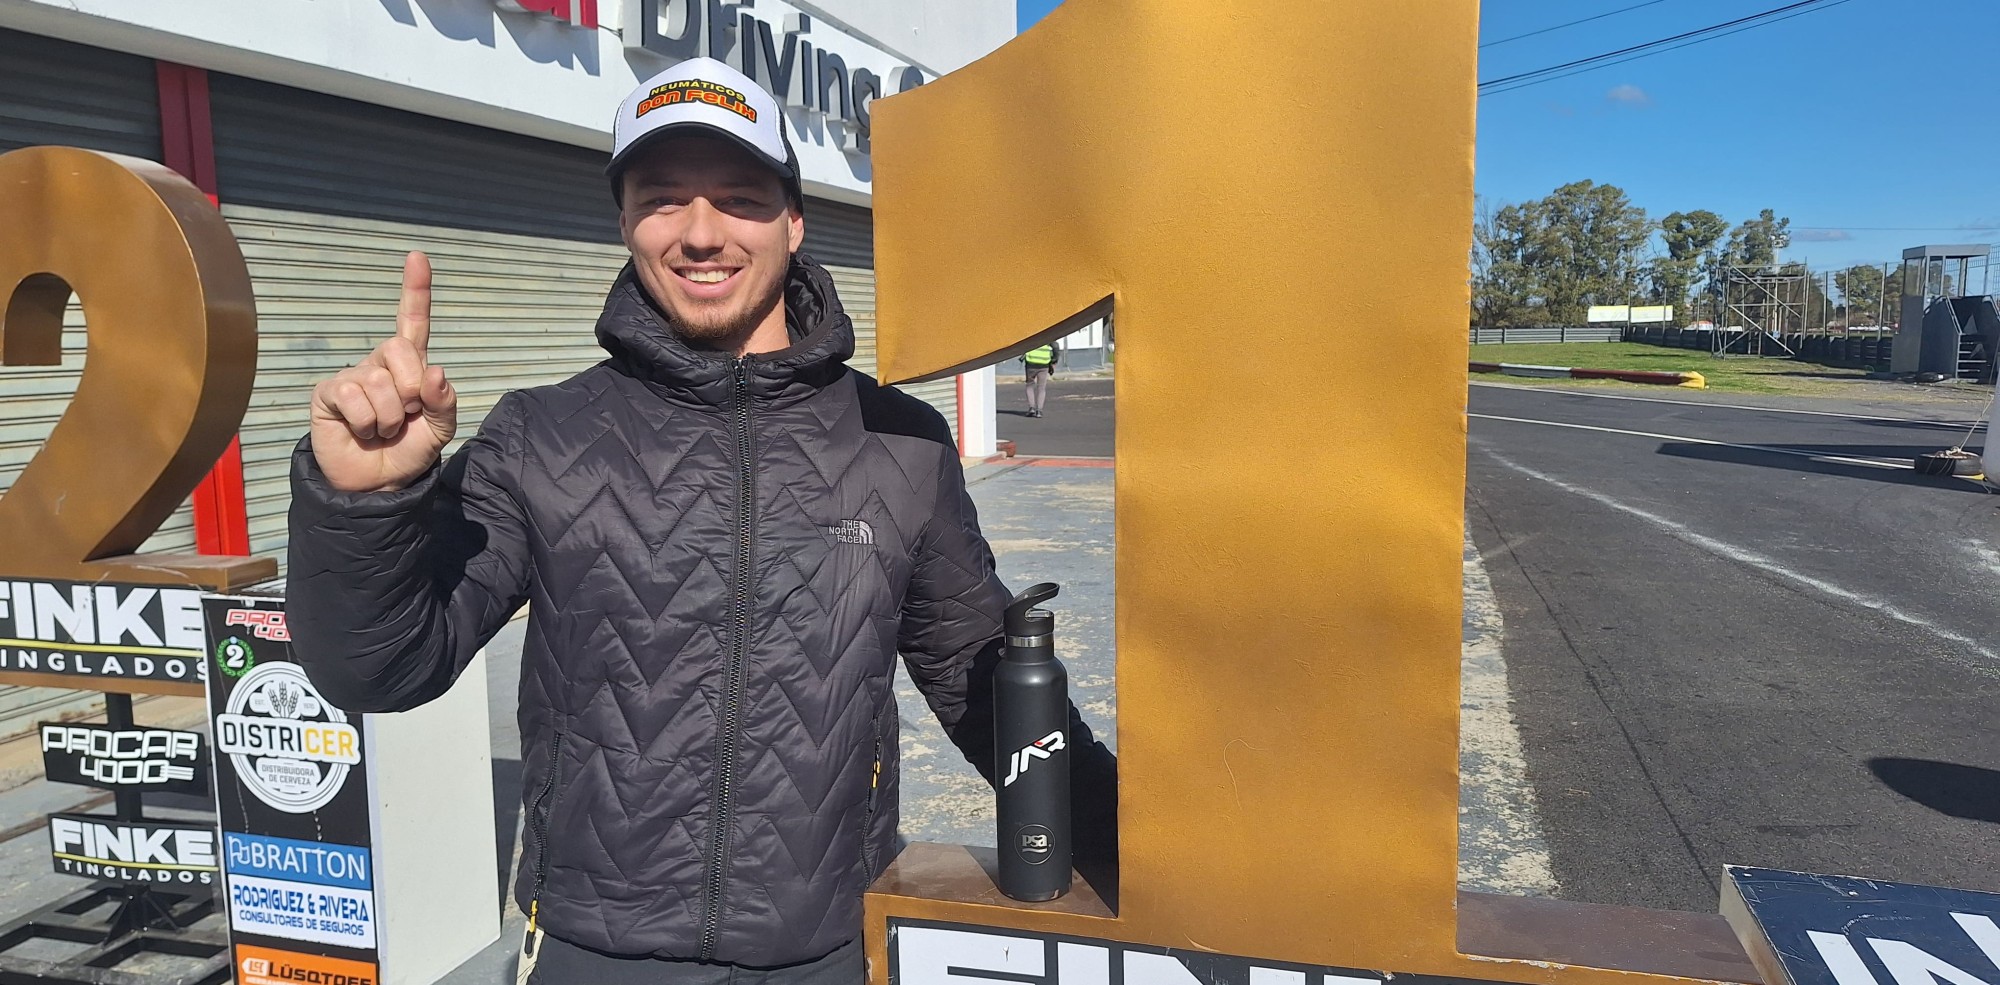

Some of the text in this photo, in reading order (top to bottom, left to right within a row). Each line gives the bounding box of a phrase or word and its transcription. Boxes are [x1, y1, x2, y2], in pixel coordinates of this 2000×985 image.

[651, 80, 745, 101] NEUMÁTICOS
[828, 526, 858, 536] NORTH
[841, 519, 859, 529] THE
[837, 535, 860, 544] FACE
[0, 580, 204, 648] INKE
[226, 609, 287, 627] PRO
[255, 625, 291, 641] 40
[0, 649, 206, 680] INGLADOS
[226, 644, 244, 668] 2
[42, 725, 198, 760] PROCAR
[223, 721, 354, 757] DISTRICER
[80, 756, 170, 784] 4000
[261, 764, 315, 777] DISTRIBUIDORA
[268, 774, 311, 785] DE CERVEZA
[51, 818, 216, 866] FINKE
[61, 859, 212, 884] TINGLADOS
[251, 842, 366, 881] BRATTON
[233, 884, 369, 922] RODRIGUEZ & RIVERA
[239, 909, 364, 936] CONSULTORES DE SEGUROS
